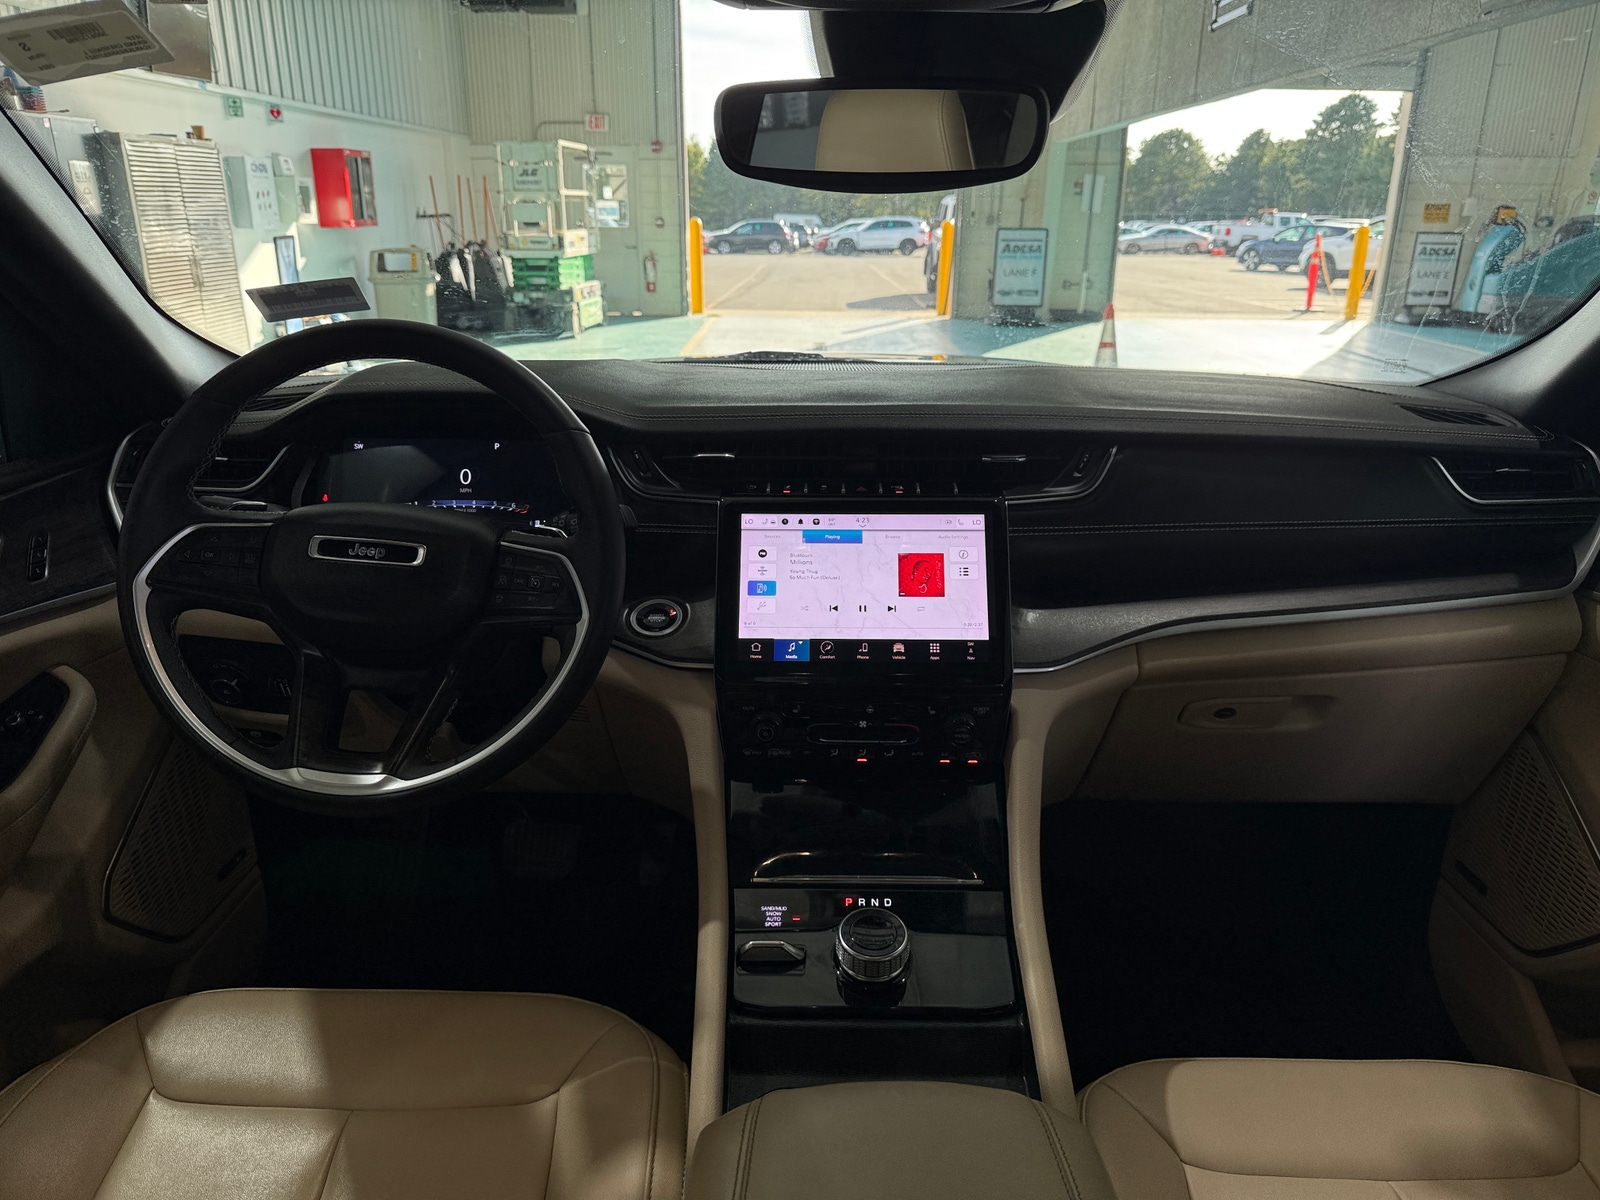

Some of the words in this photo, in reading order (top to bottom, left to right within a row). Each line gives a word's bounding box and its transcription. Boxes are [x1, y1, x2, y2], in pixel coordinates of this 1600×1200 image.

[588, 114, 605, 130] EXIT
[519, 168, 539, 177] JLG
[1002, 268, 1029, 278] LANE
[1416, 270, 1444, 279] LANE
[460, 468, 472, 484] 0
[348, 543, 386, 559] Jeep
[845, 898, 852, 906] P
[858, 898, 866, 906] R
[871, 898, 879, 906] N
[884, 898, 892, 906] D
